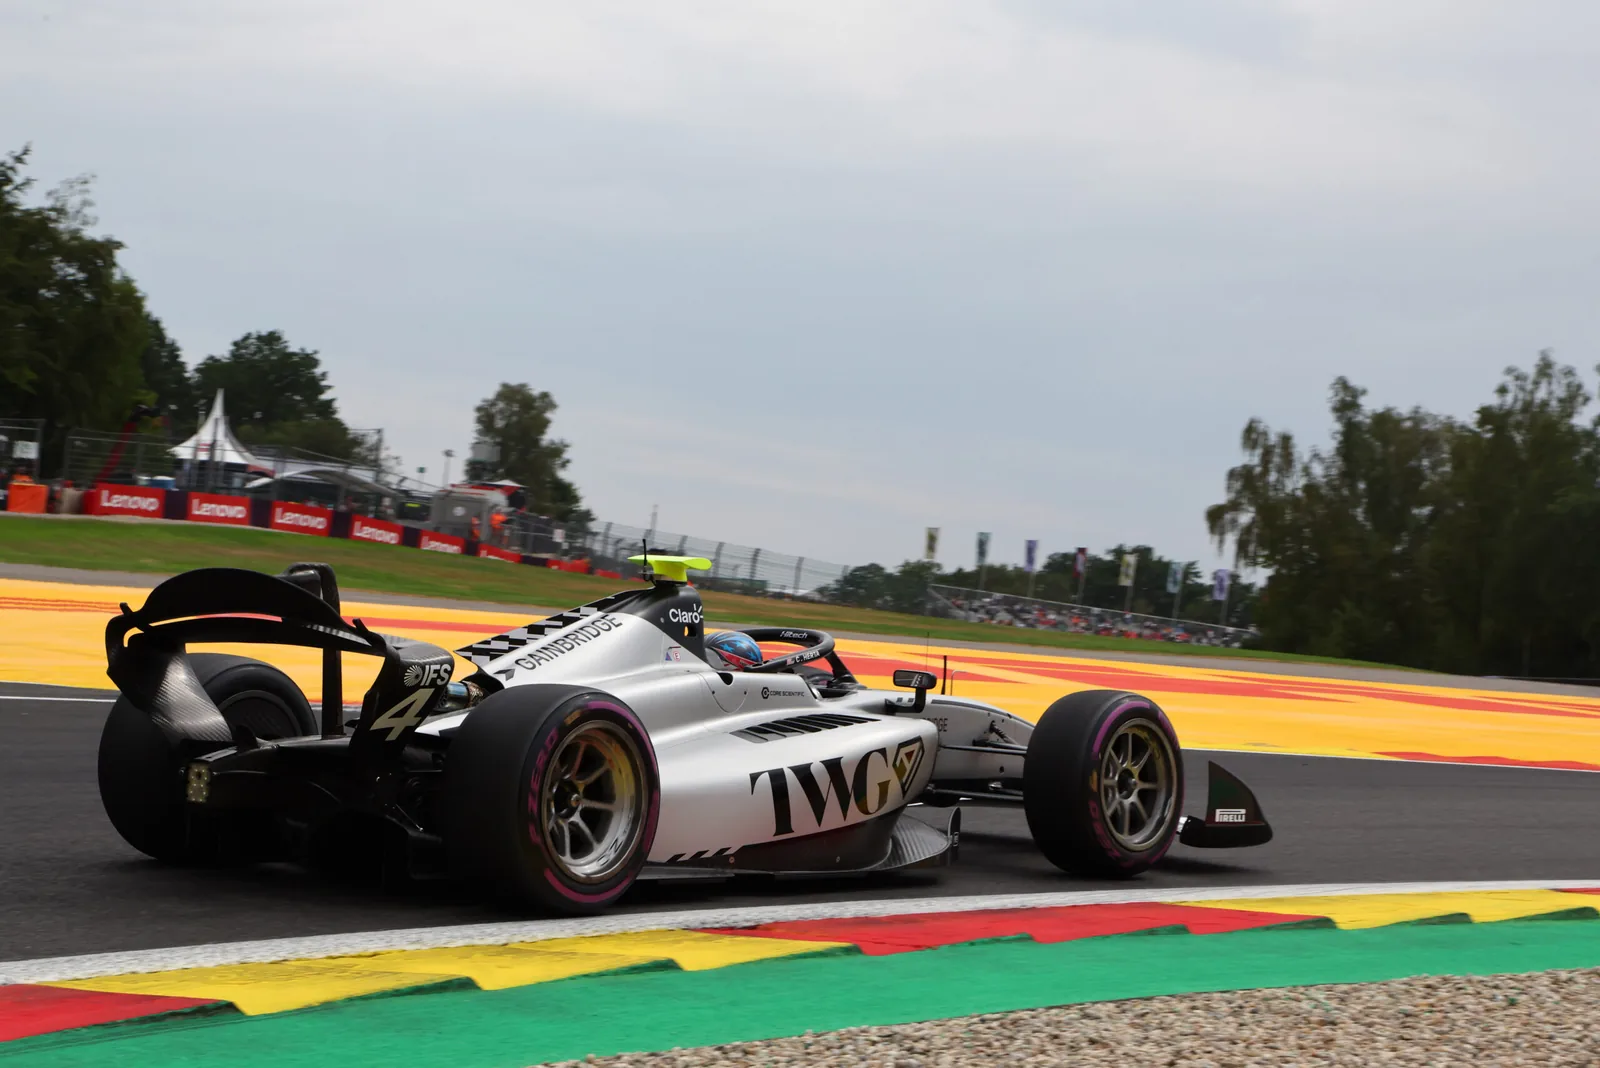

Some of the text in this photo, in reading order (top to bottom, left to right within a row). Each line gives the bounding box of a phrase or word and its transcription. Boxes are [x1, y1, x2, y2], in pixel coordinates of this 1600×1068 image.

[101, 489, 160, 511] Lenovo
[191, 498, 247, 519] Lenovo
[274, 507, 327, 530] Lenovo
[353, 520, 400, 545] Lenovo
[669, 607, 701, 624] Claro
[514, 613, 624, 671] GAINBRIDGE
[780, 630, 808, 639] Hitech
[803, 649, 820, 661] HERTA
[420, 663, 452, 686] IFS
[369, 688, 436, 741] 4
[749, 747, 891, 837] TWG
[1215, 808, 1246, 823] PIRELLI
